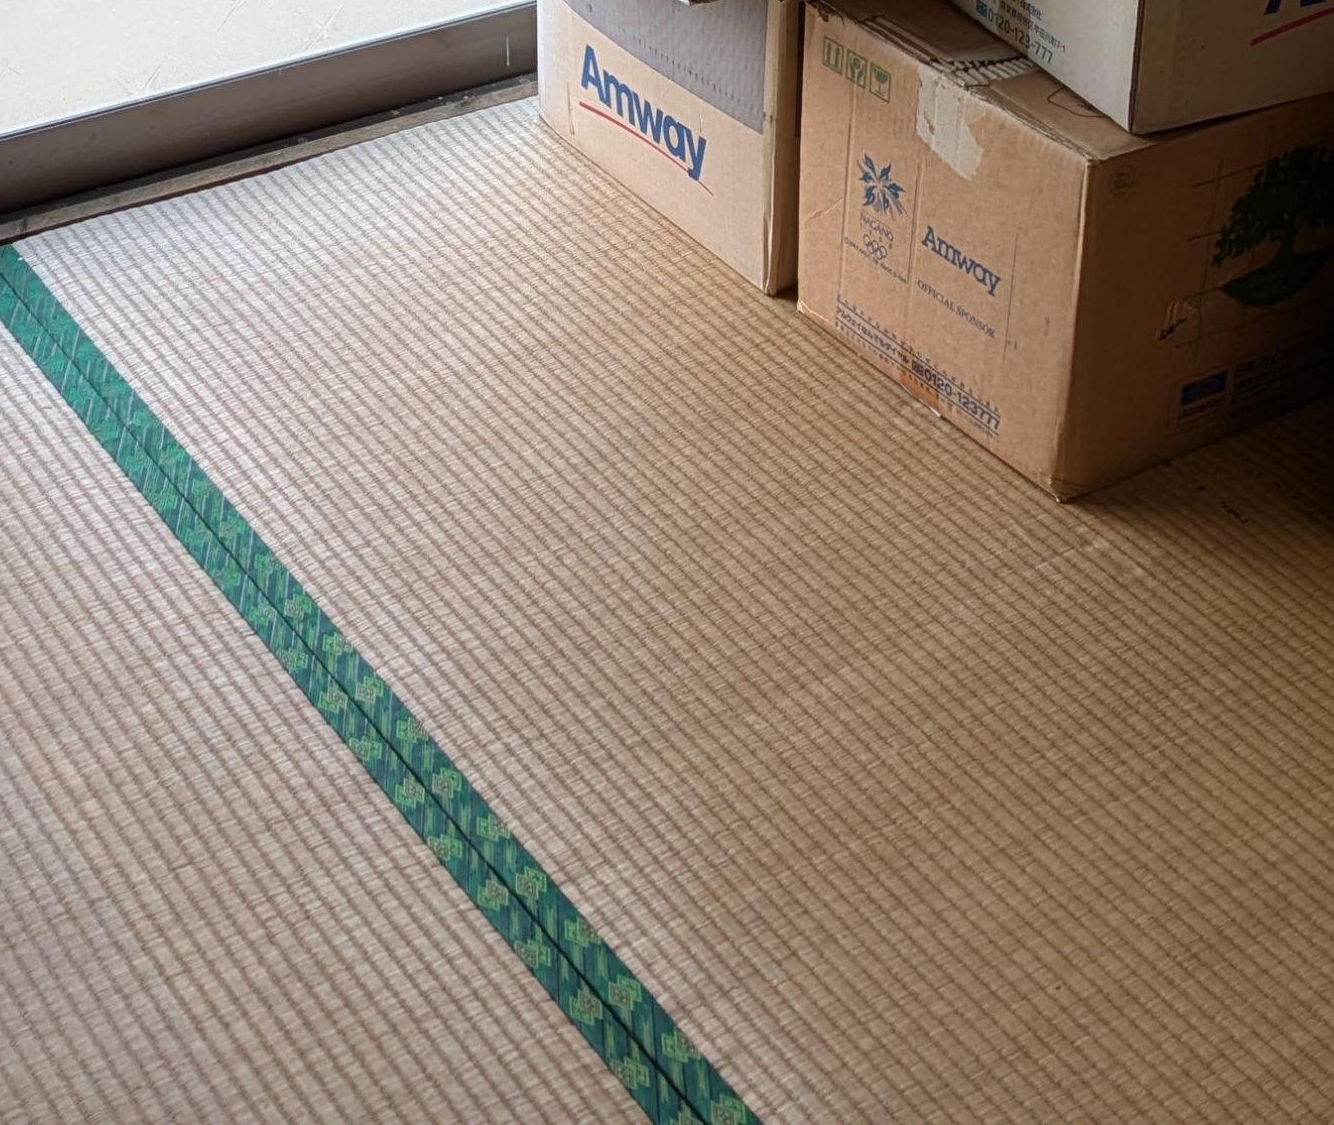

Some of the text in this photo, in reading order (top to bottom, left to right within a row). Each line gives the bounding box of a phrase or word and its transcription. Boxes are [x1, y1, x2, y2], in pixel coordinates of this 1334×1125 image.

[581, 43, 707, 181] Amway
[921, 225, 1002, 297] Amway
[917, 279, 996, 340] OFFICIAL SPONSOR
